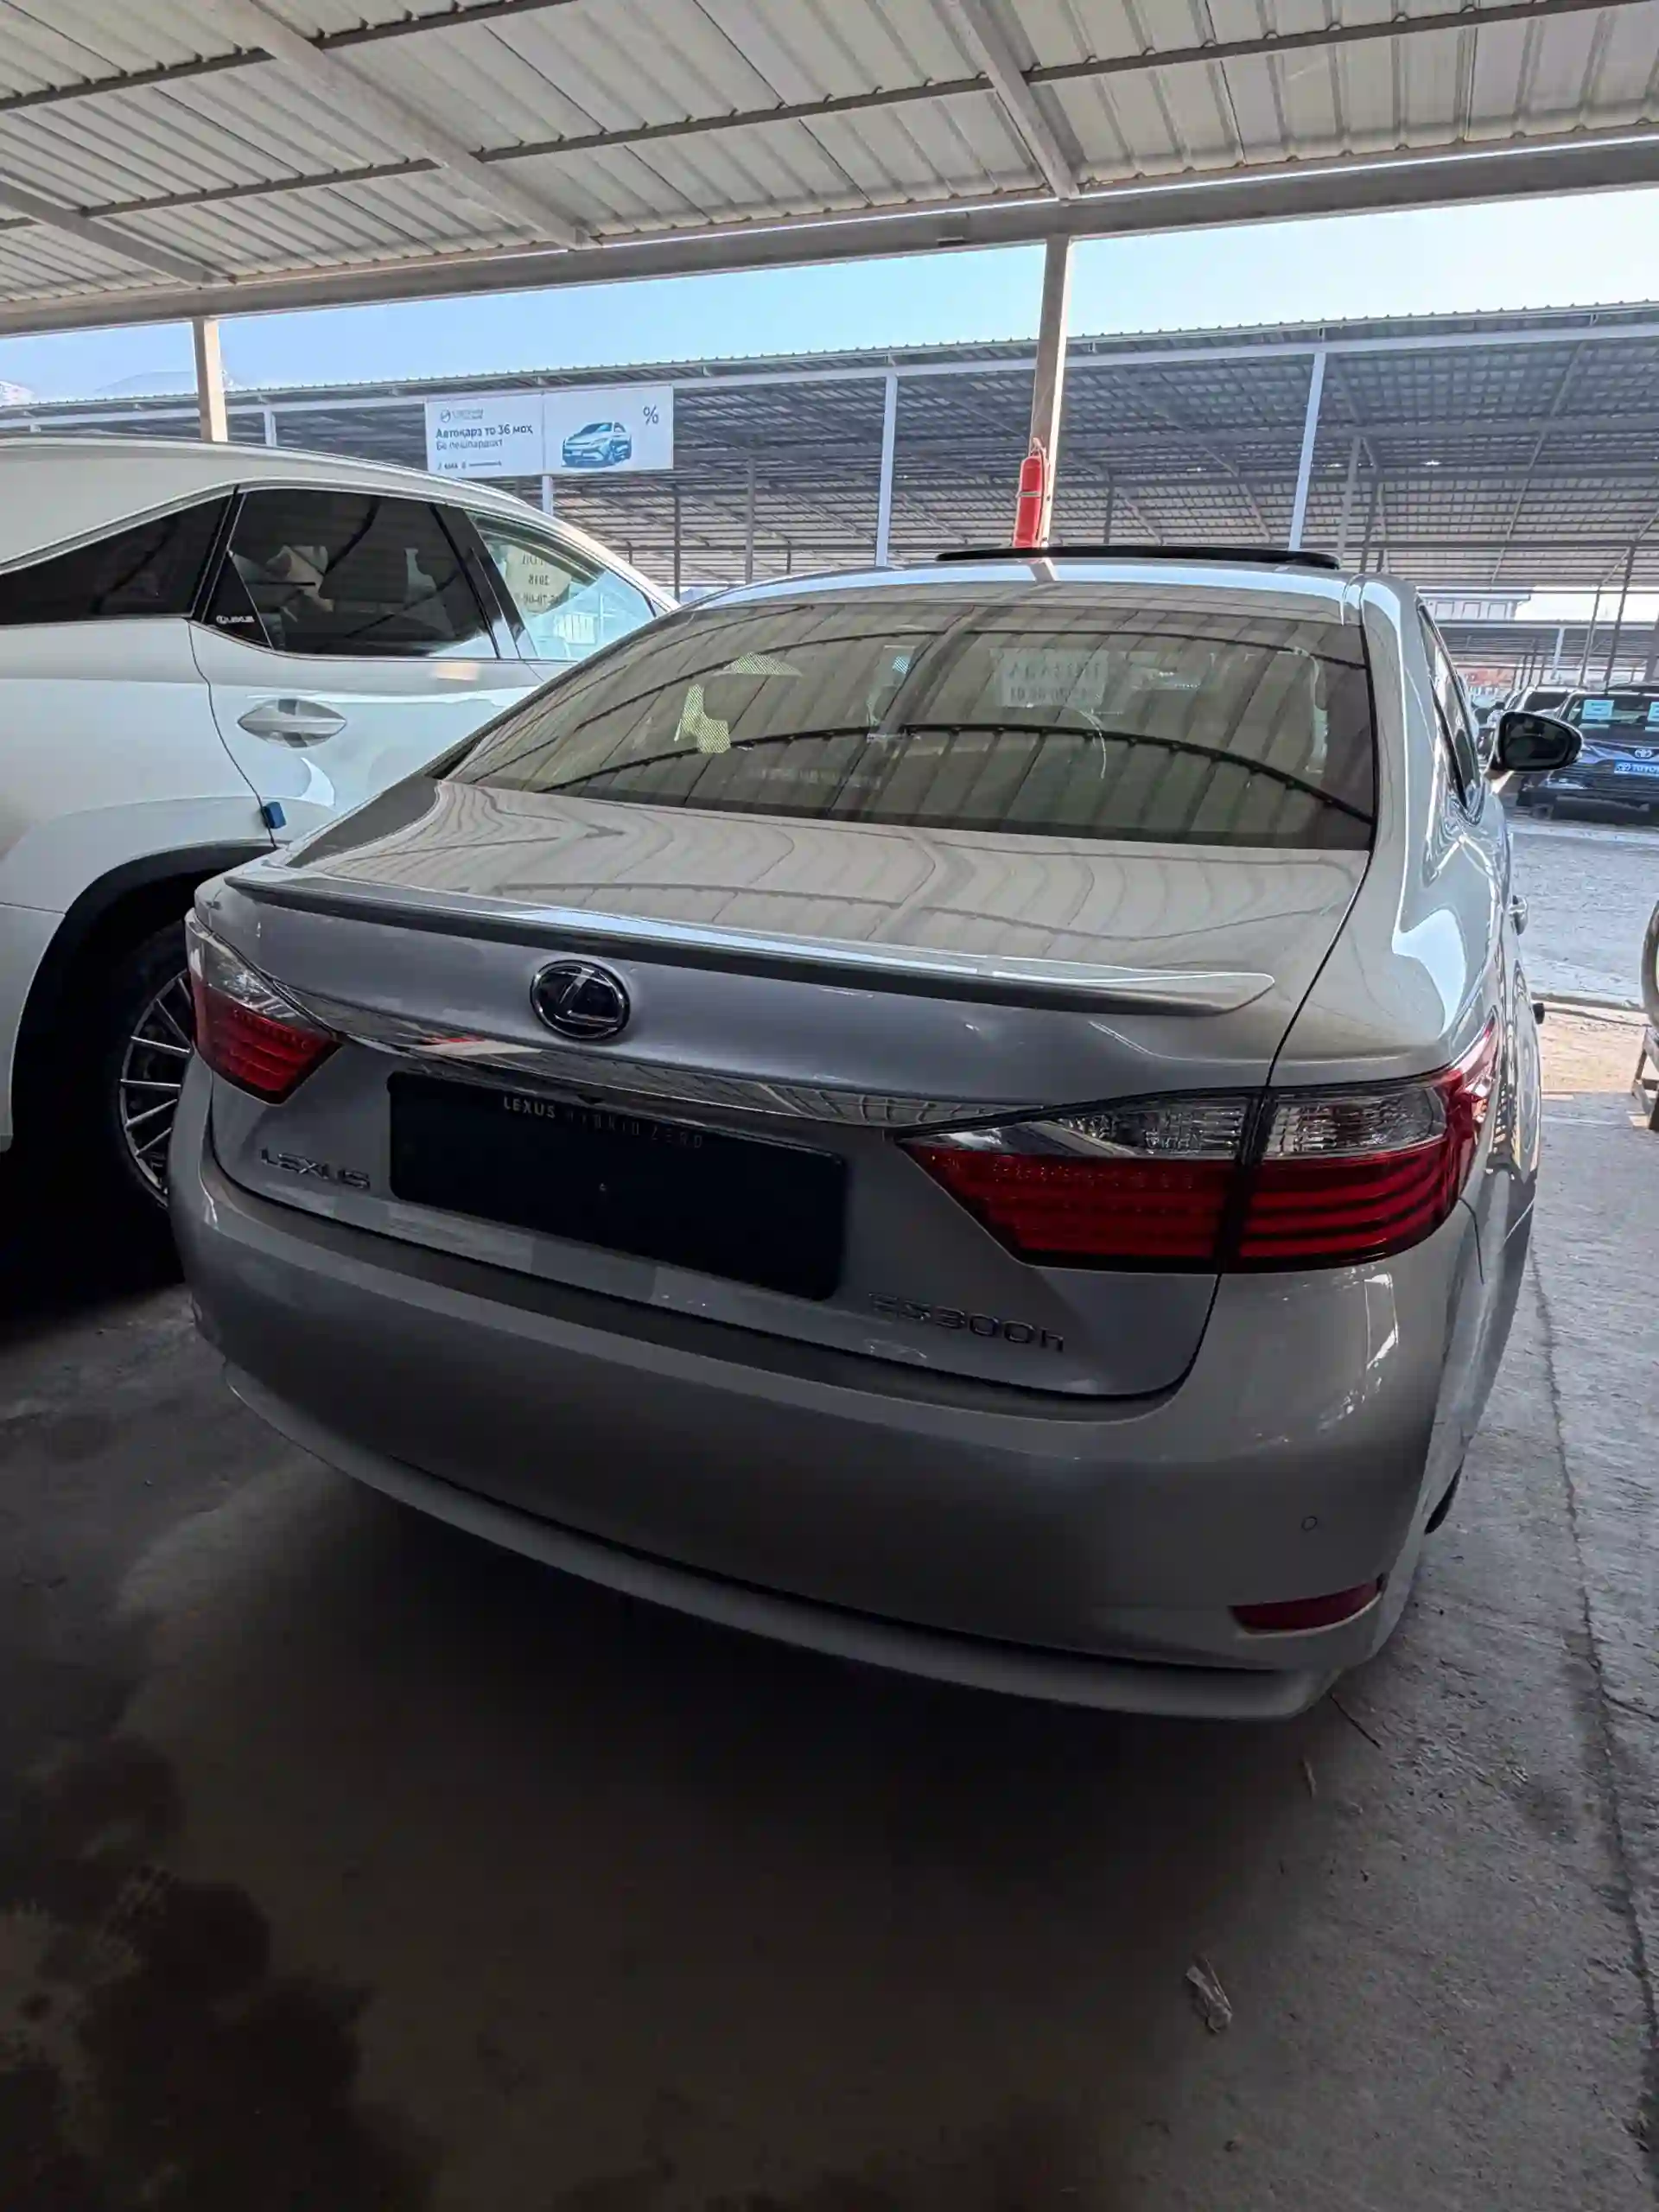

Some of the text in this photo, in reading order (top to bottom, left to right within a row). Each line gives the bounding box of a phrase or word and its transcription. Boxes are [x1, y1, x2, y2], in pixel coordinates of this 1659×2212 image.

[498, 424, 511, 435] 36
[503, 1095, 556, 1119] LEXUS
[259, 1147, 372, 1191] LEXUS
